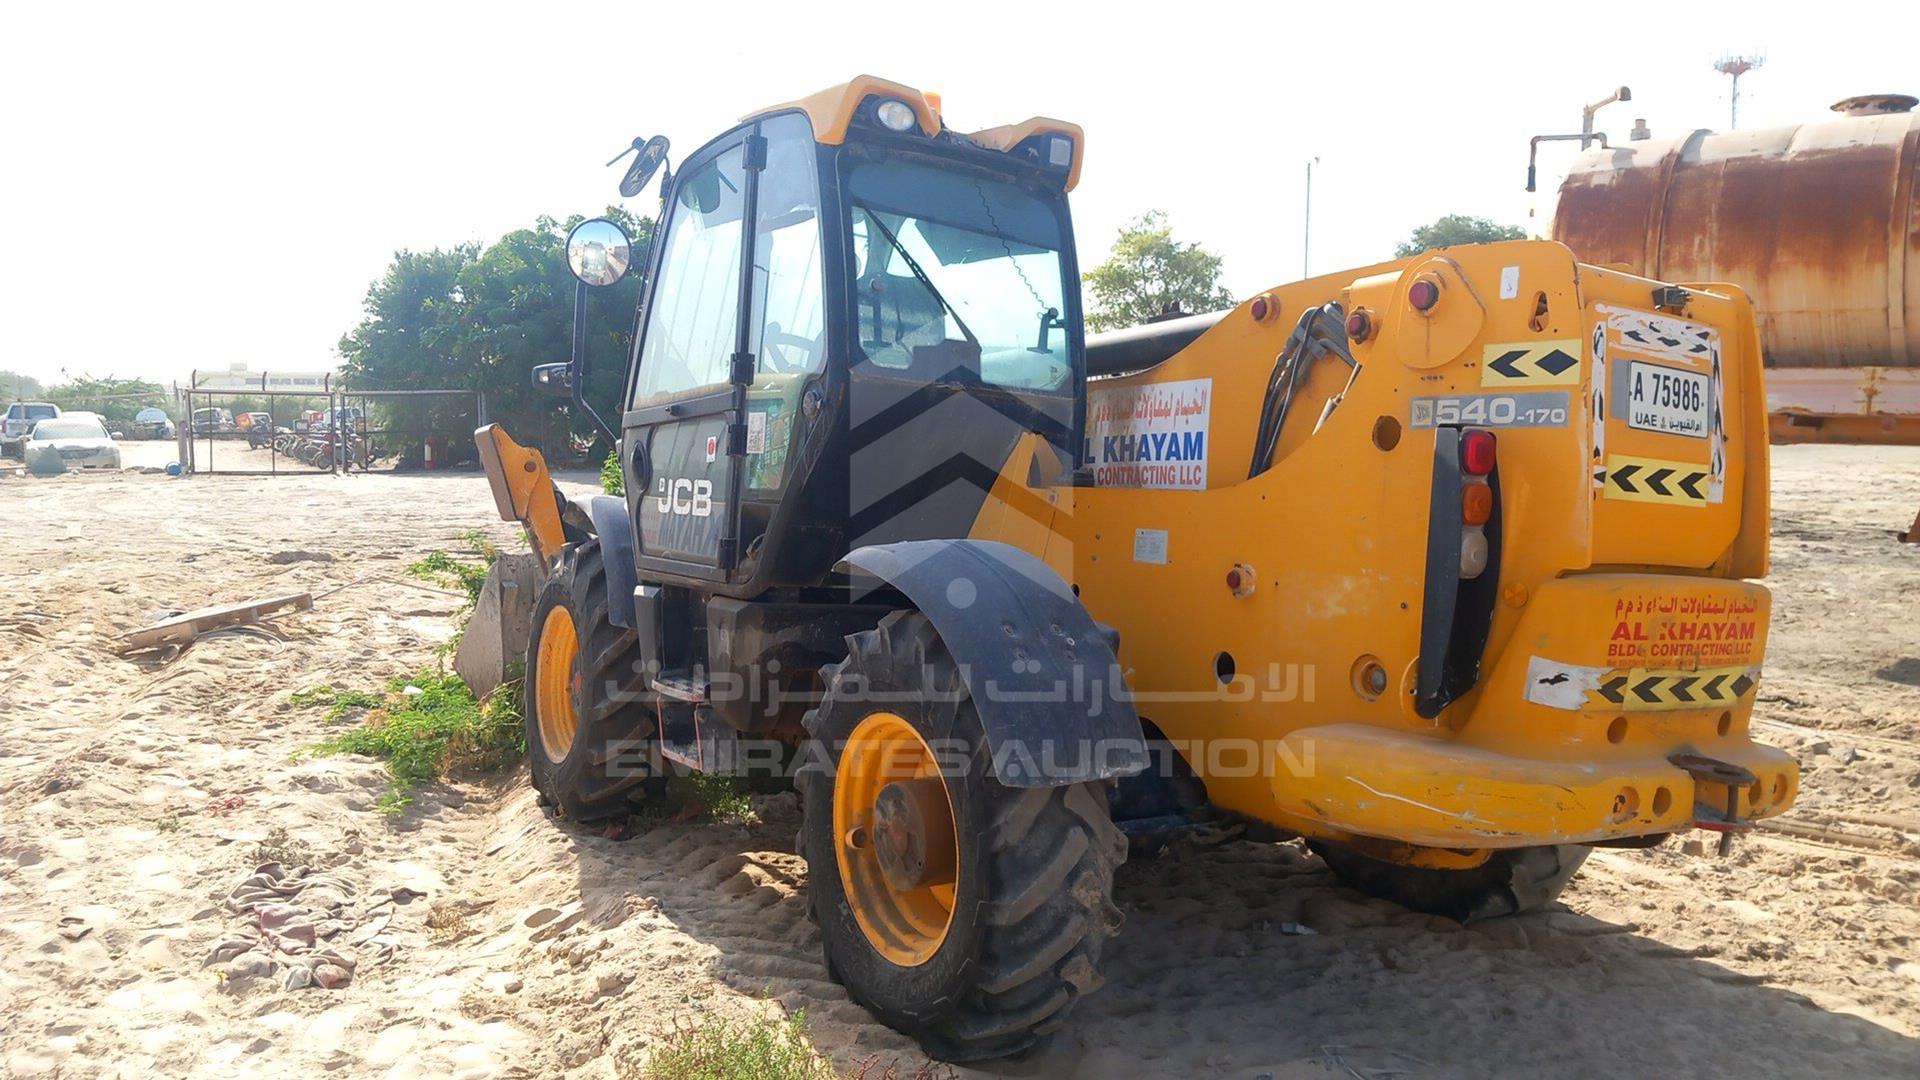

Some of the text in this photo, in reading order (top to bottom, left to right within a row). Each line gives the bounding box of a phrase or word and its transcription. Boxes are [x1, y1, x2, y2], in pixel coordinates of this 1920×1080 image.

[1633, 371, 1700, 412] A 75986
[1435, 397, 1566, 425] 540-170
[1635, 412, 1657, 427] UAE
[1084, 431, 1204, 464] L KHAYAM
[1097, 465, 1176, 485] CONTRACTING
[1180, 465, 1202, 485] LLC
[657, 478, 713, 518] JCB
[1611, 621, 1756, 640] AL KHAYAM
[1734, 642, 1752, 656] LLC
